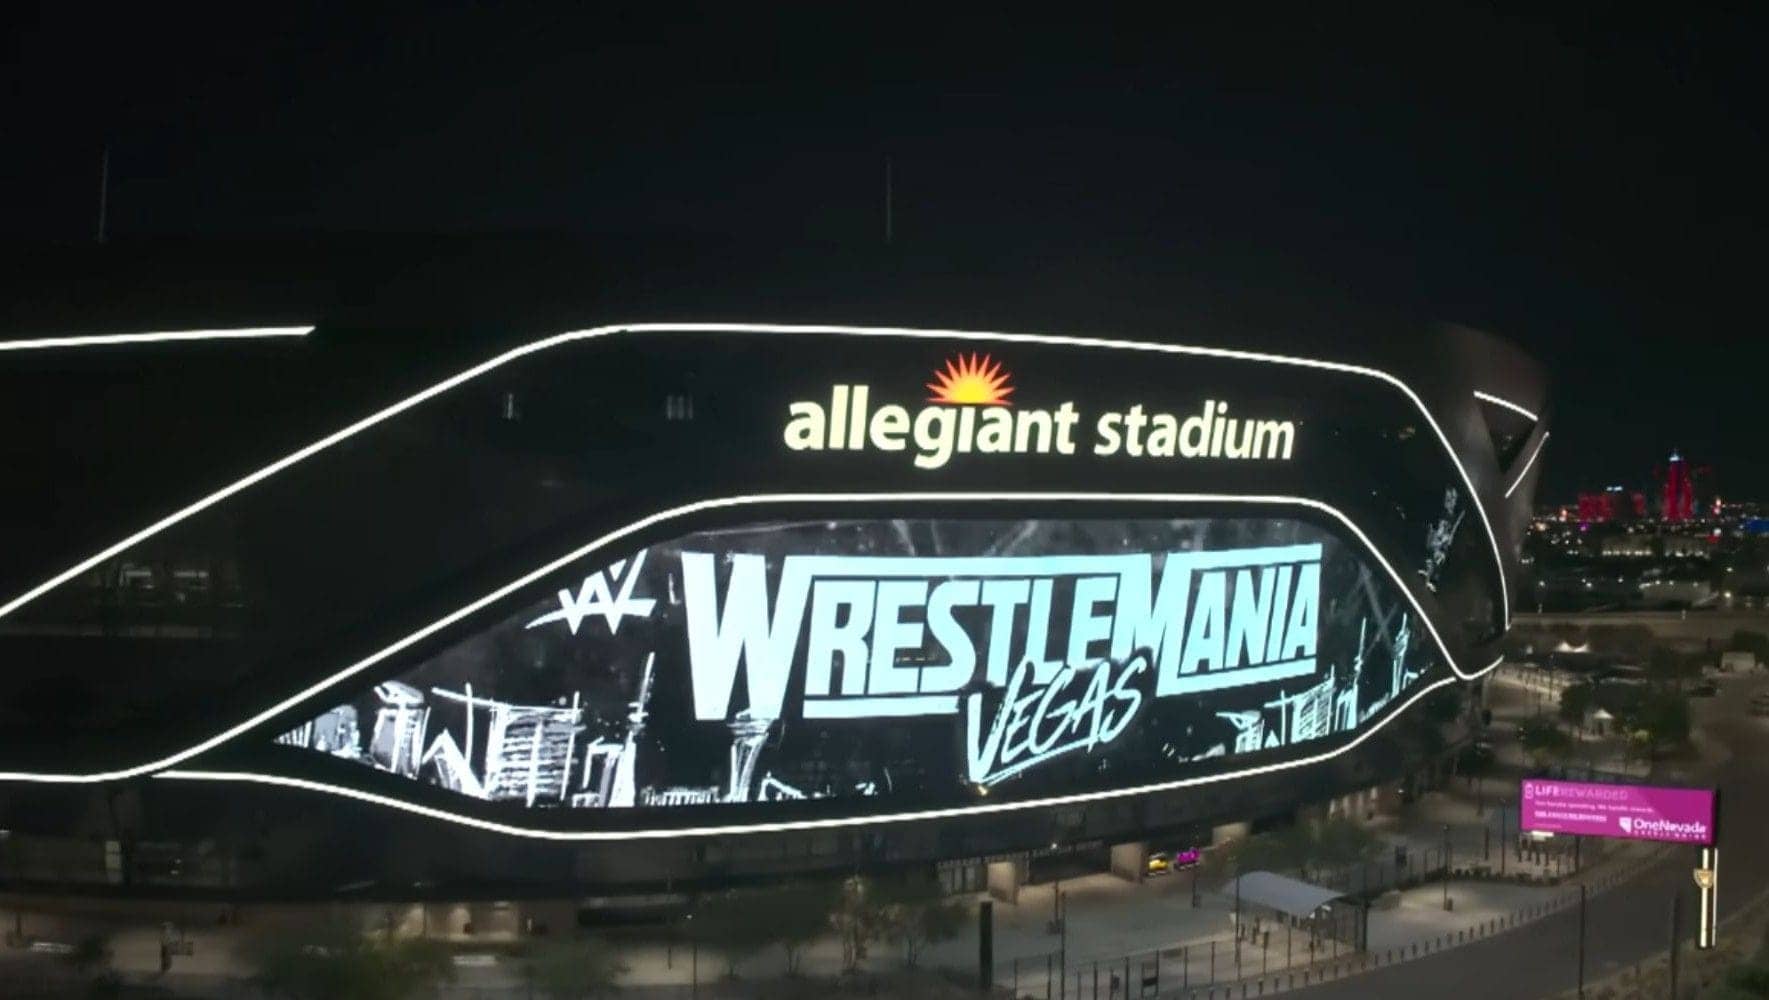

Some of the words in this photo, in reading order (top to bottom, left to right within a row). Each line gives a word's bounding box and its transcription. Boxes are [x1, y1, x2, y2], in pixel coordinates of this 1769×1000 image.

[783, 384, 1079, 469] allegiant
[1093, 399, 1295, 461] stadium
[681, 543, 1323, 721] WRESTLEMANIA
[966, 655, 1148, 786] VEGAS
